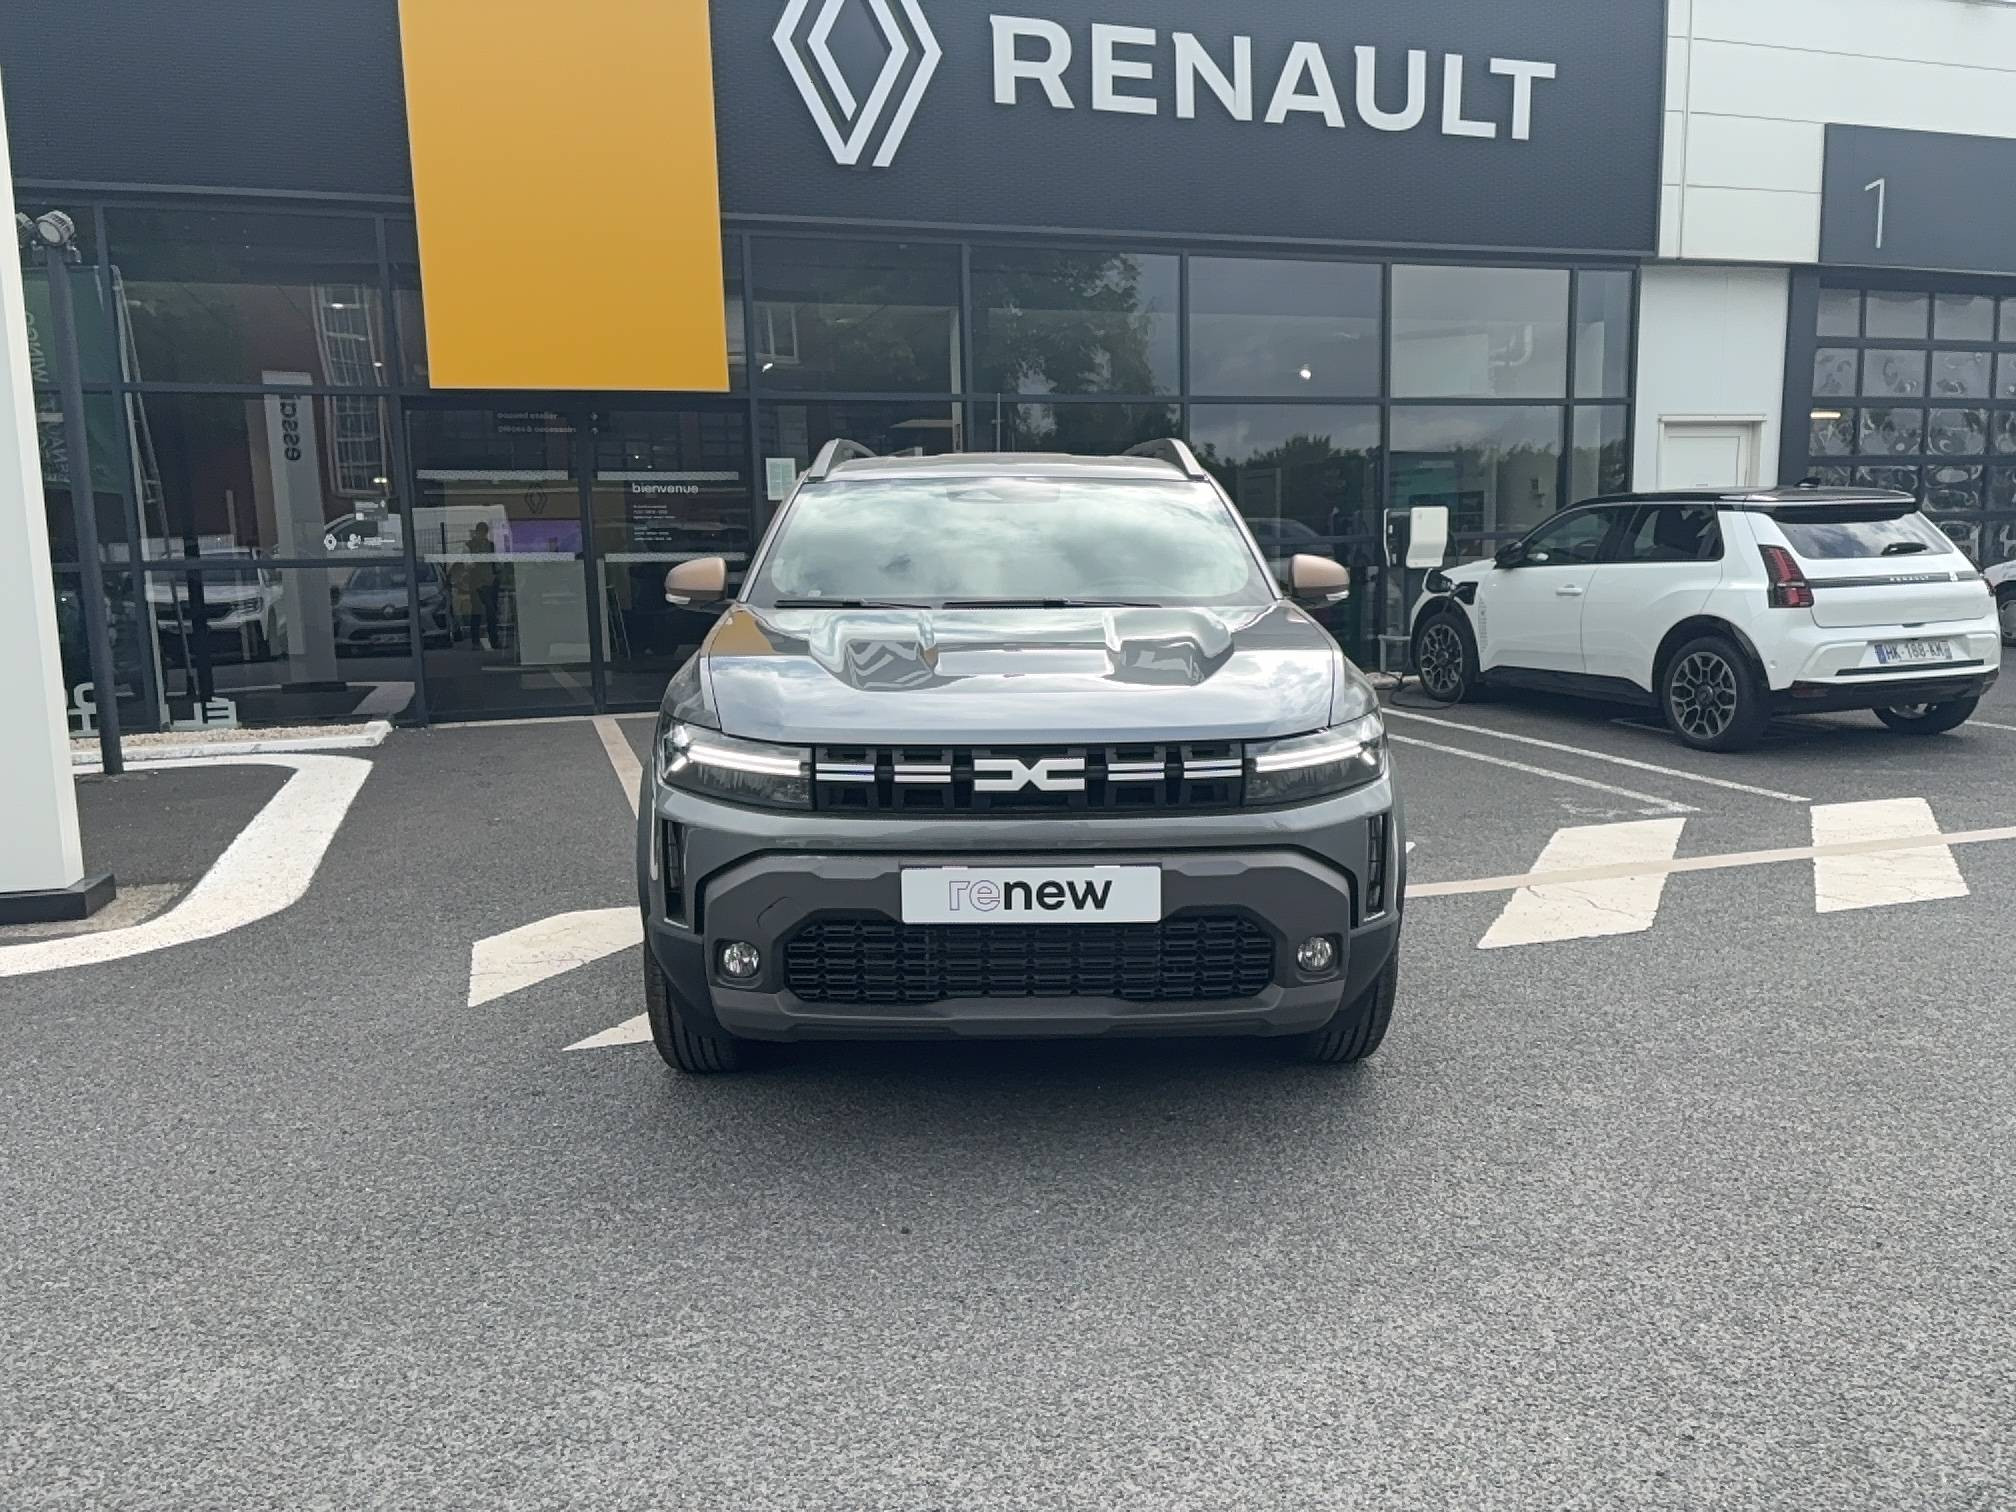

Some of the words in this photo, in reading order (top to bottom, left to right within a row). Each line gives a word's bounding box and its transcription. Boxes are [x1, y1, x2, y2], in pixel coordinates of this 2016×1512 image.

[988, 14, 1557, 141] RENAULT
[1863, 178, 1886, 249] 1
[632, 482, 699, 495] bienvenue
[948, 879, 1113, 912] renew
